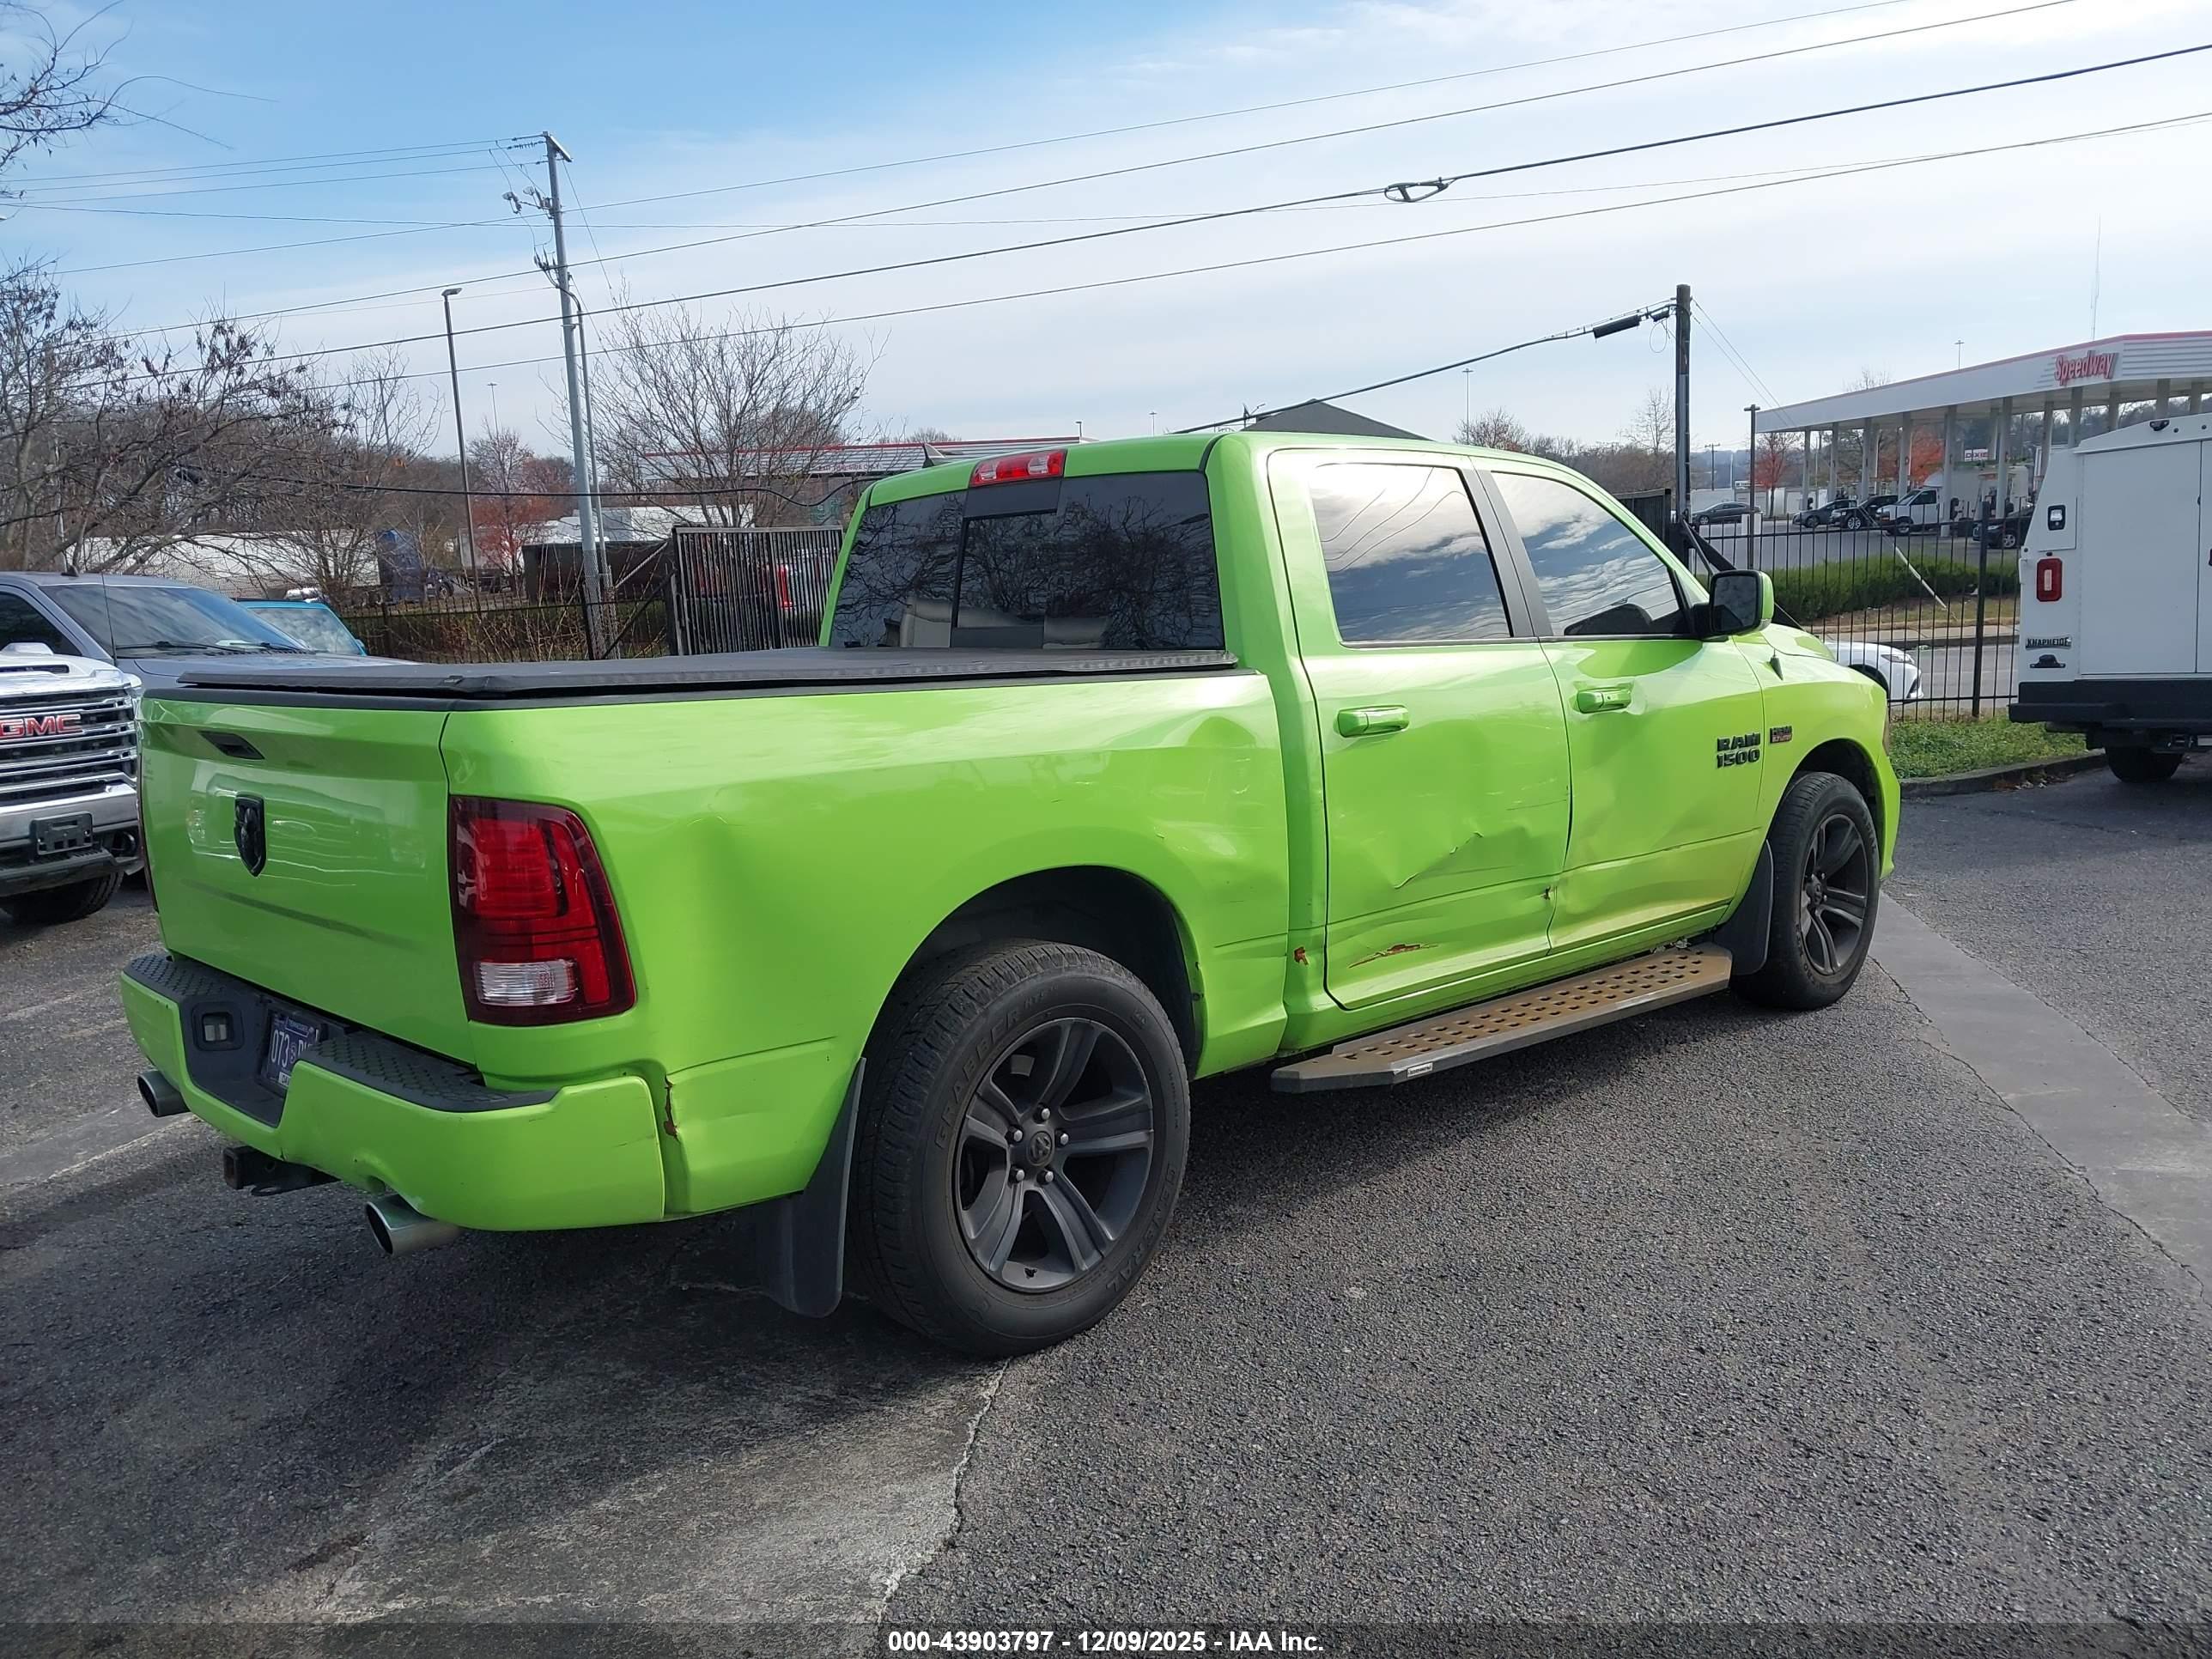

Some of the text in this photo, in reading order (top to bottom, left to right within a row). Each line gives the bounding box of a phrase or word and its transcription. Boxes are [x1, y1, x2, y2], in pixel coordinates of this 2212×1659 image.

[2055, 351, 2118, 386] Speedway
[2027, 637, 2070, 647] KNAPHEIDE
[0, 714, 82, 738] GMC
[1717, 732, 1760, 752] RAM
[1717, 748, 1760, 769] 1500
[271, 1030, 290, 1067] 073
[934, 1010, 1018, 1150] GRABBER
